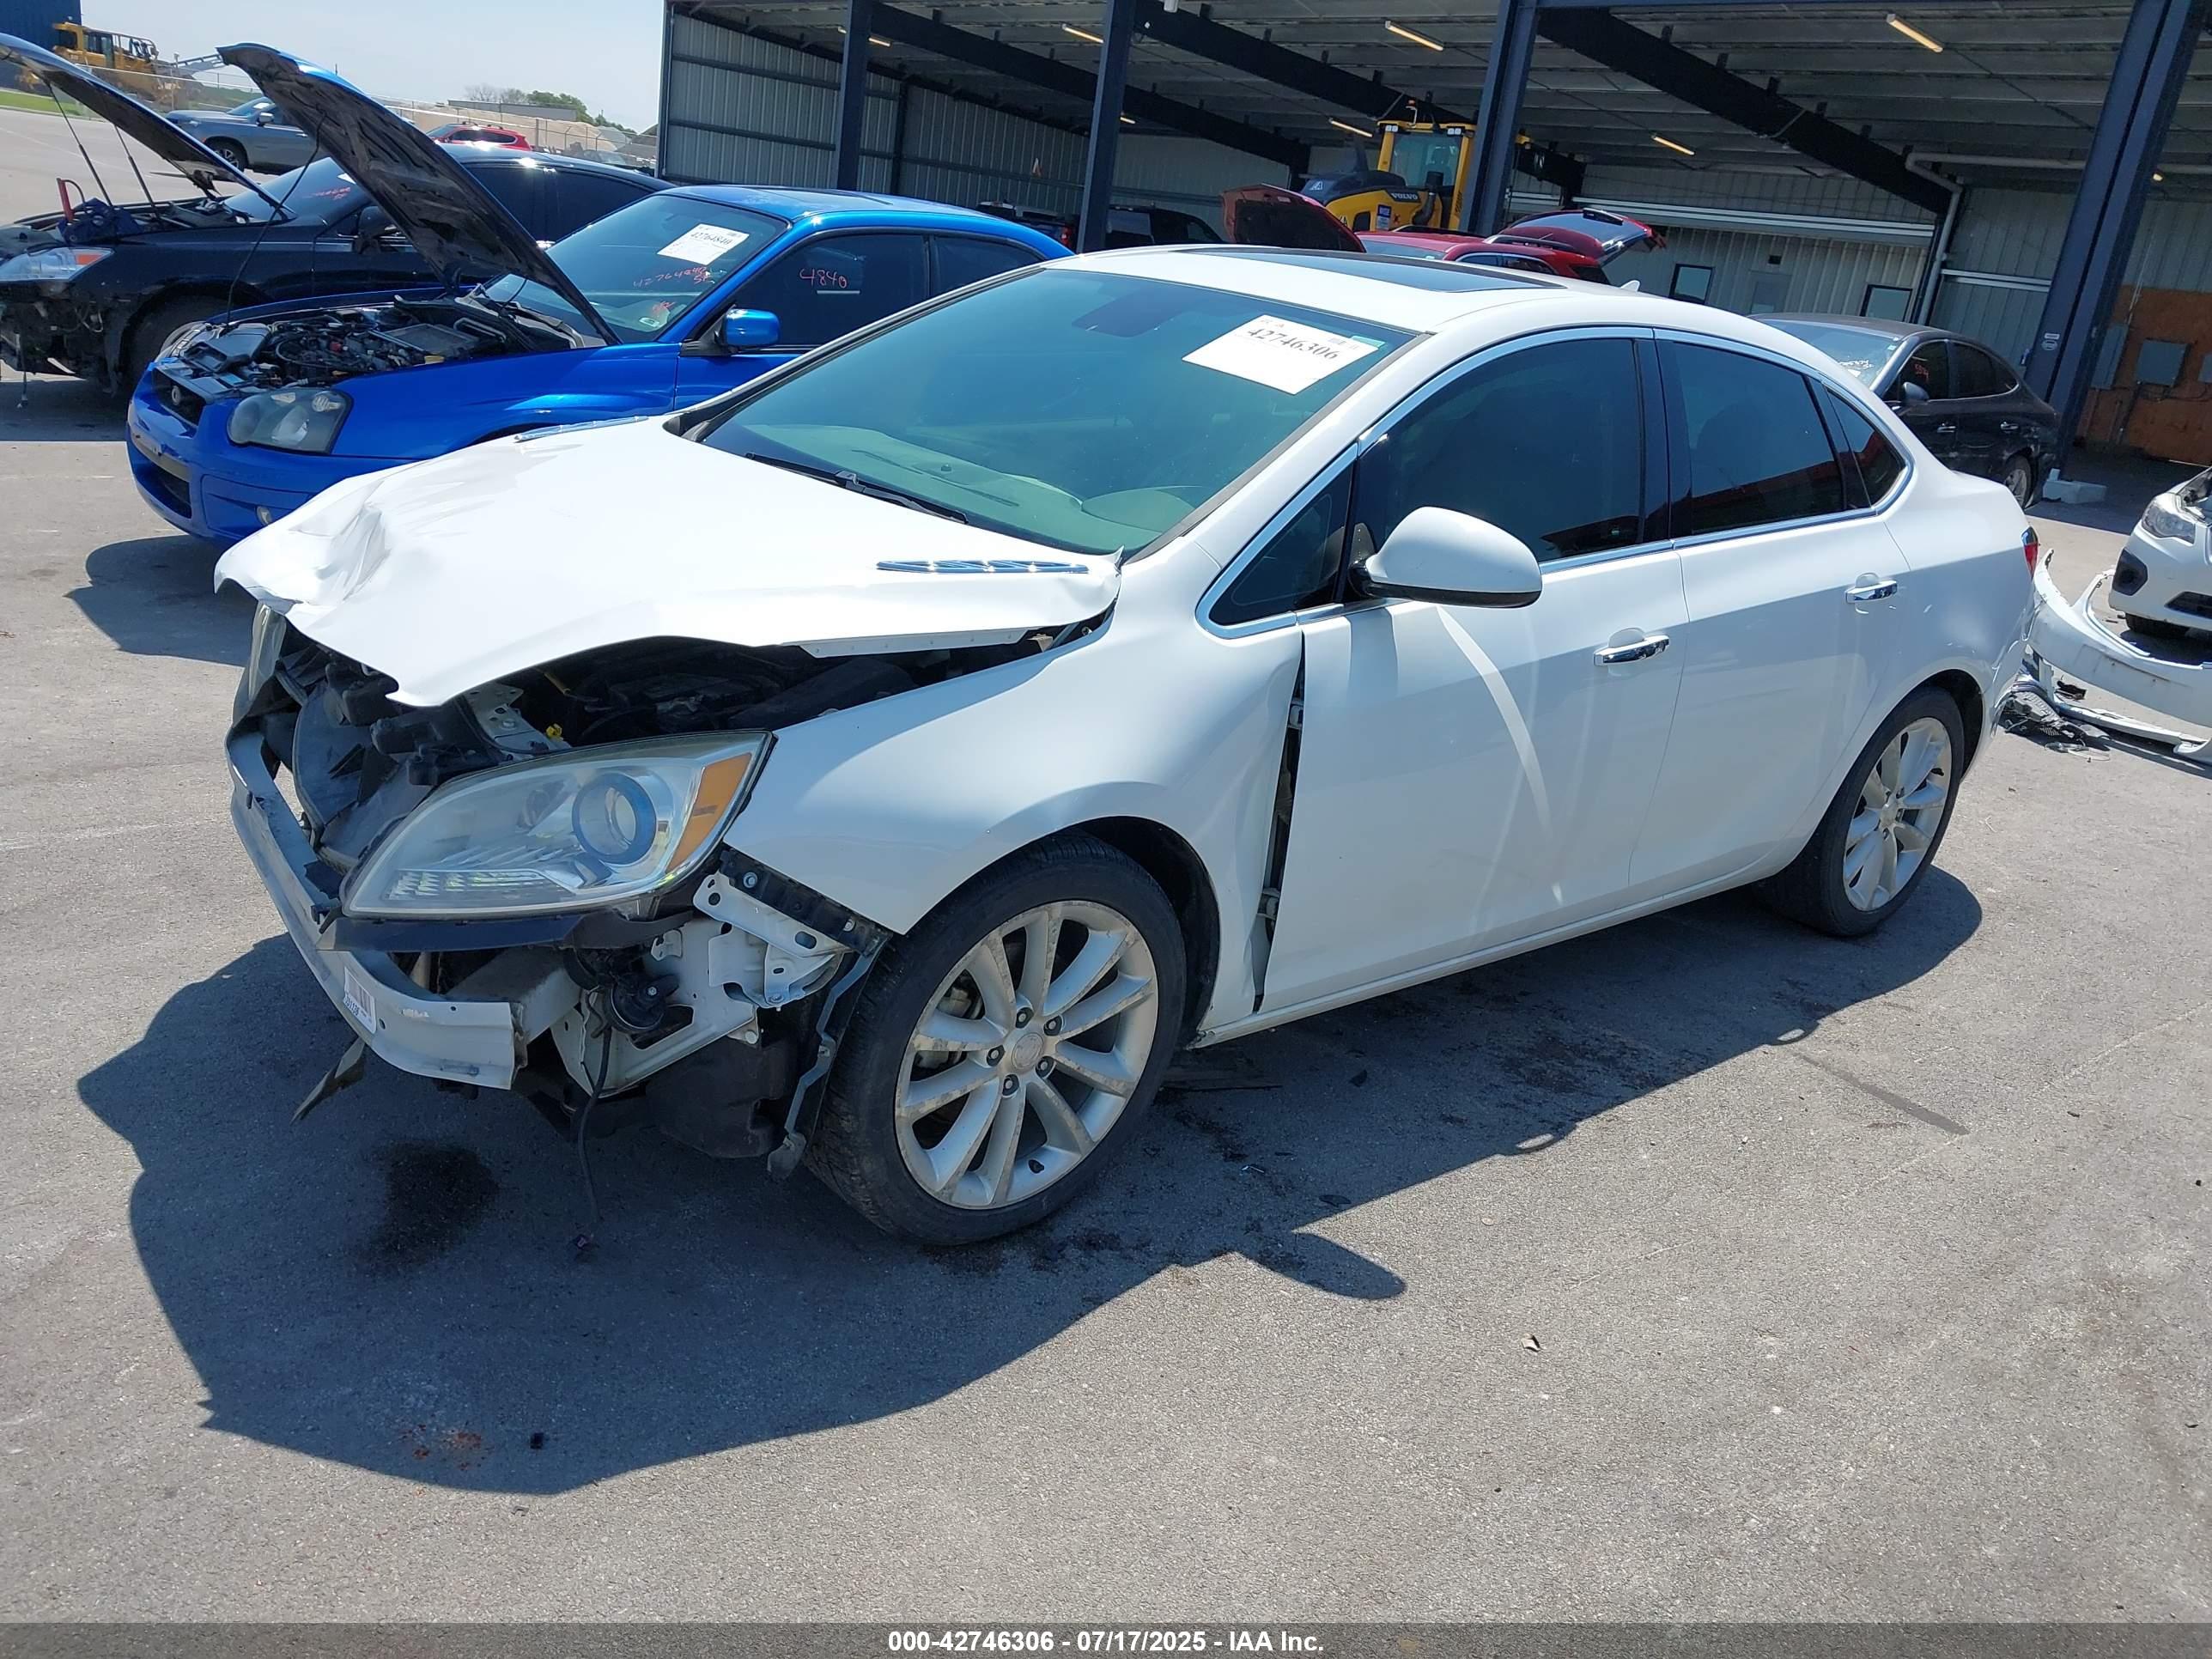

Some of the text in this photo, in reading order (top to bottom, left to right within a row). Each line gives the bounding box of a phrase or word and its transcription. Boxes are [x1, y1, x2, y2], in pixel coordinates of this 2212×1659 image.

[1391, 192, 1418, 201] VOLVO
[799, 268, 848, 289] 4840
[1248, 328, 1339, 360] 42746306
